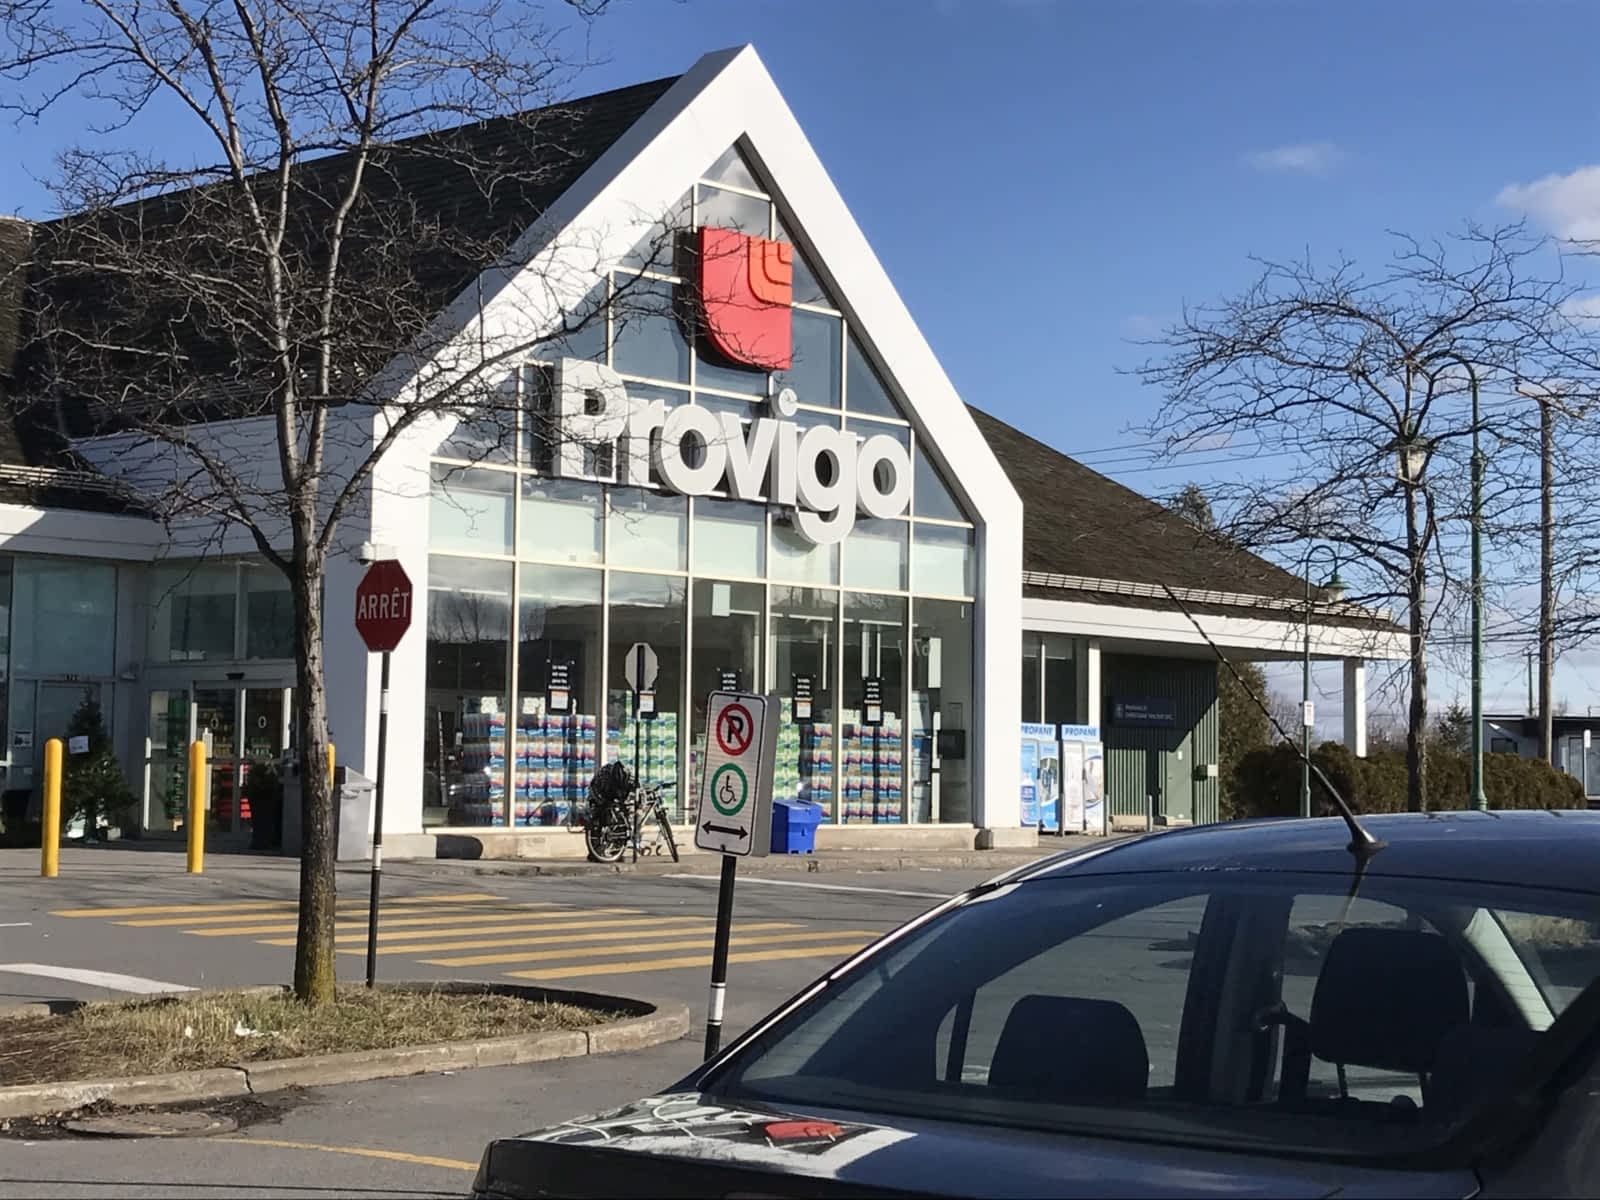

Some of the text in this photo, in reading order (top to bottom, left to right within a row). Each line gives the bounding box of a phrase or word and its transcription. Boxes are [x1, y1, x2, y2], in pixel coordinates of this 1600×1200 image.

[555, 357, 911, 545] Provigo
[357, 586, 410, 619] ARRÊT
[1064, 727, 1097, 737] PROPANE
